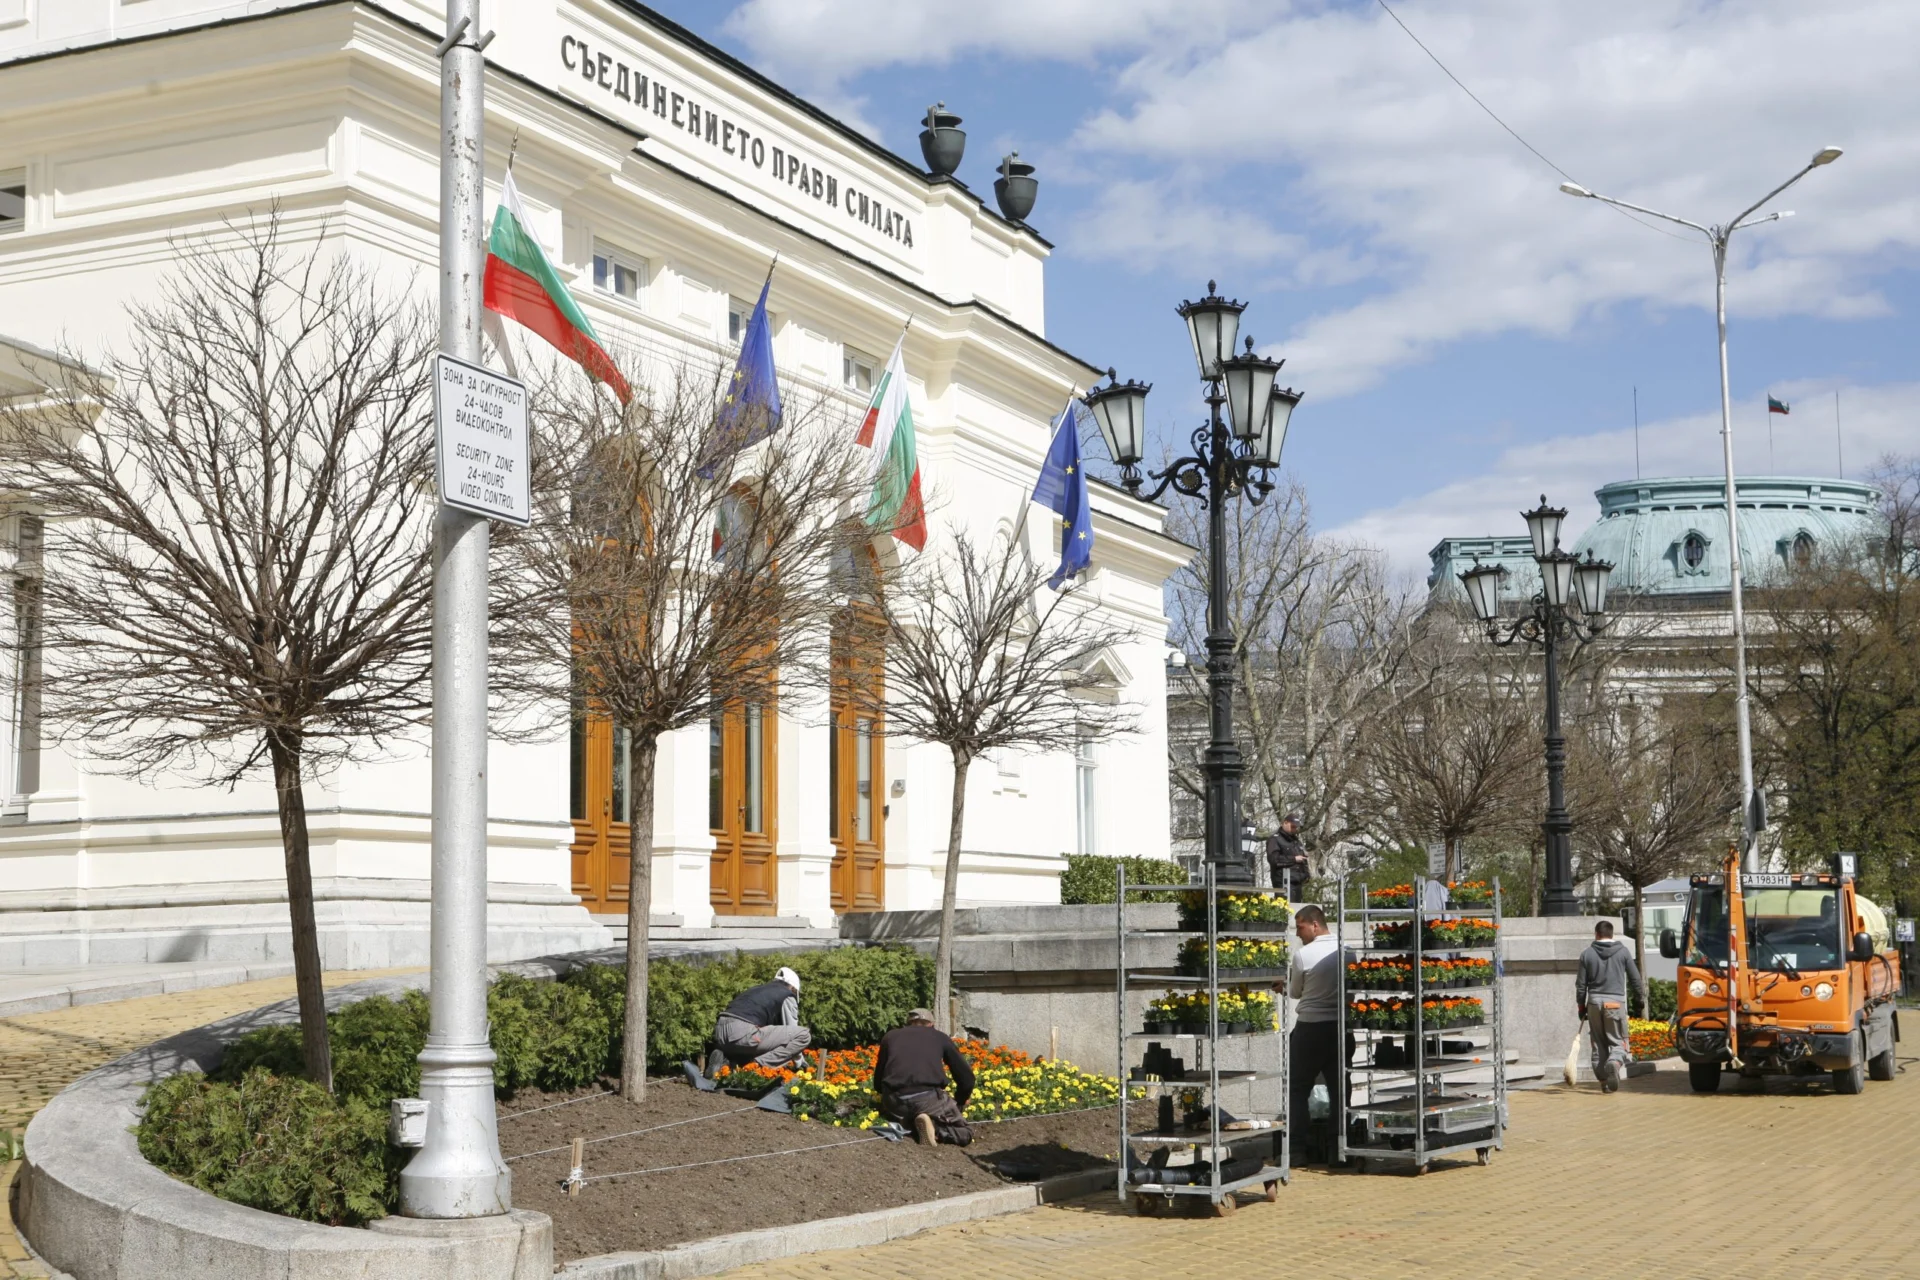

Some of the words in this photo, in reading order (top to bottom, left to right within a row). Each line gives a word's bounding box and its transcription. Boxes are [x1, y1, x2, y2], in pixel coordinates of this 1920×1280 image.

[560, 34, 766, 169] СЪЕДИНЕНИЕТО
[771, 146, 838, 208] ПРАВИ
[844, 187, 914, 248] СИЛАТА
[443, 367, 464, 386] ЗОНА
[467, 376, 477, 391] ЗА
[480, 380, 521, 406] СИГУРНОСТ
[464, 394, 503, 419] 24-ЧАСОВ
[455, 409, 512, 441] ВИДЕОКОНТРОЛ
[456, 443, 491, 465] SECURITY
[495, 455, 514, 473] ZONE
[467, 466, 505, 489] 24-HOURS
[460, 481, 481, 500] VIDEO
[483, 488, 514, 510] CONTROL
[1756, 875, 1776, 885] 1983
